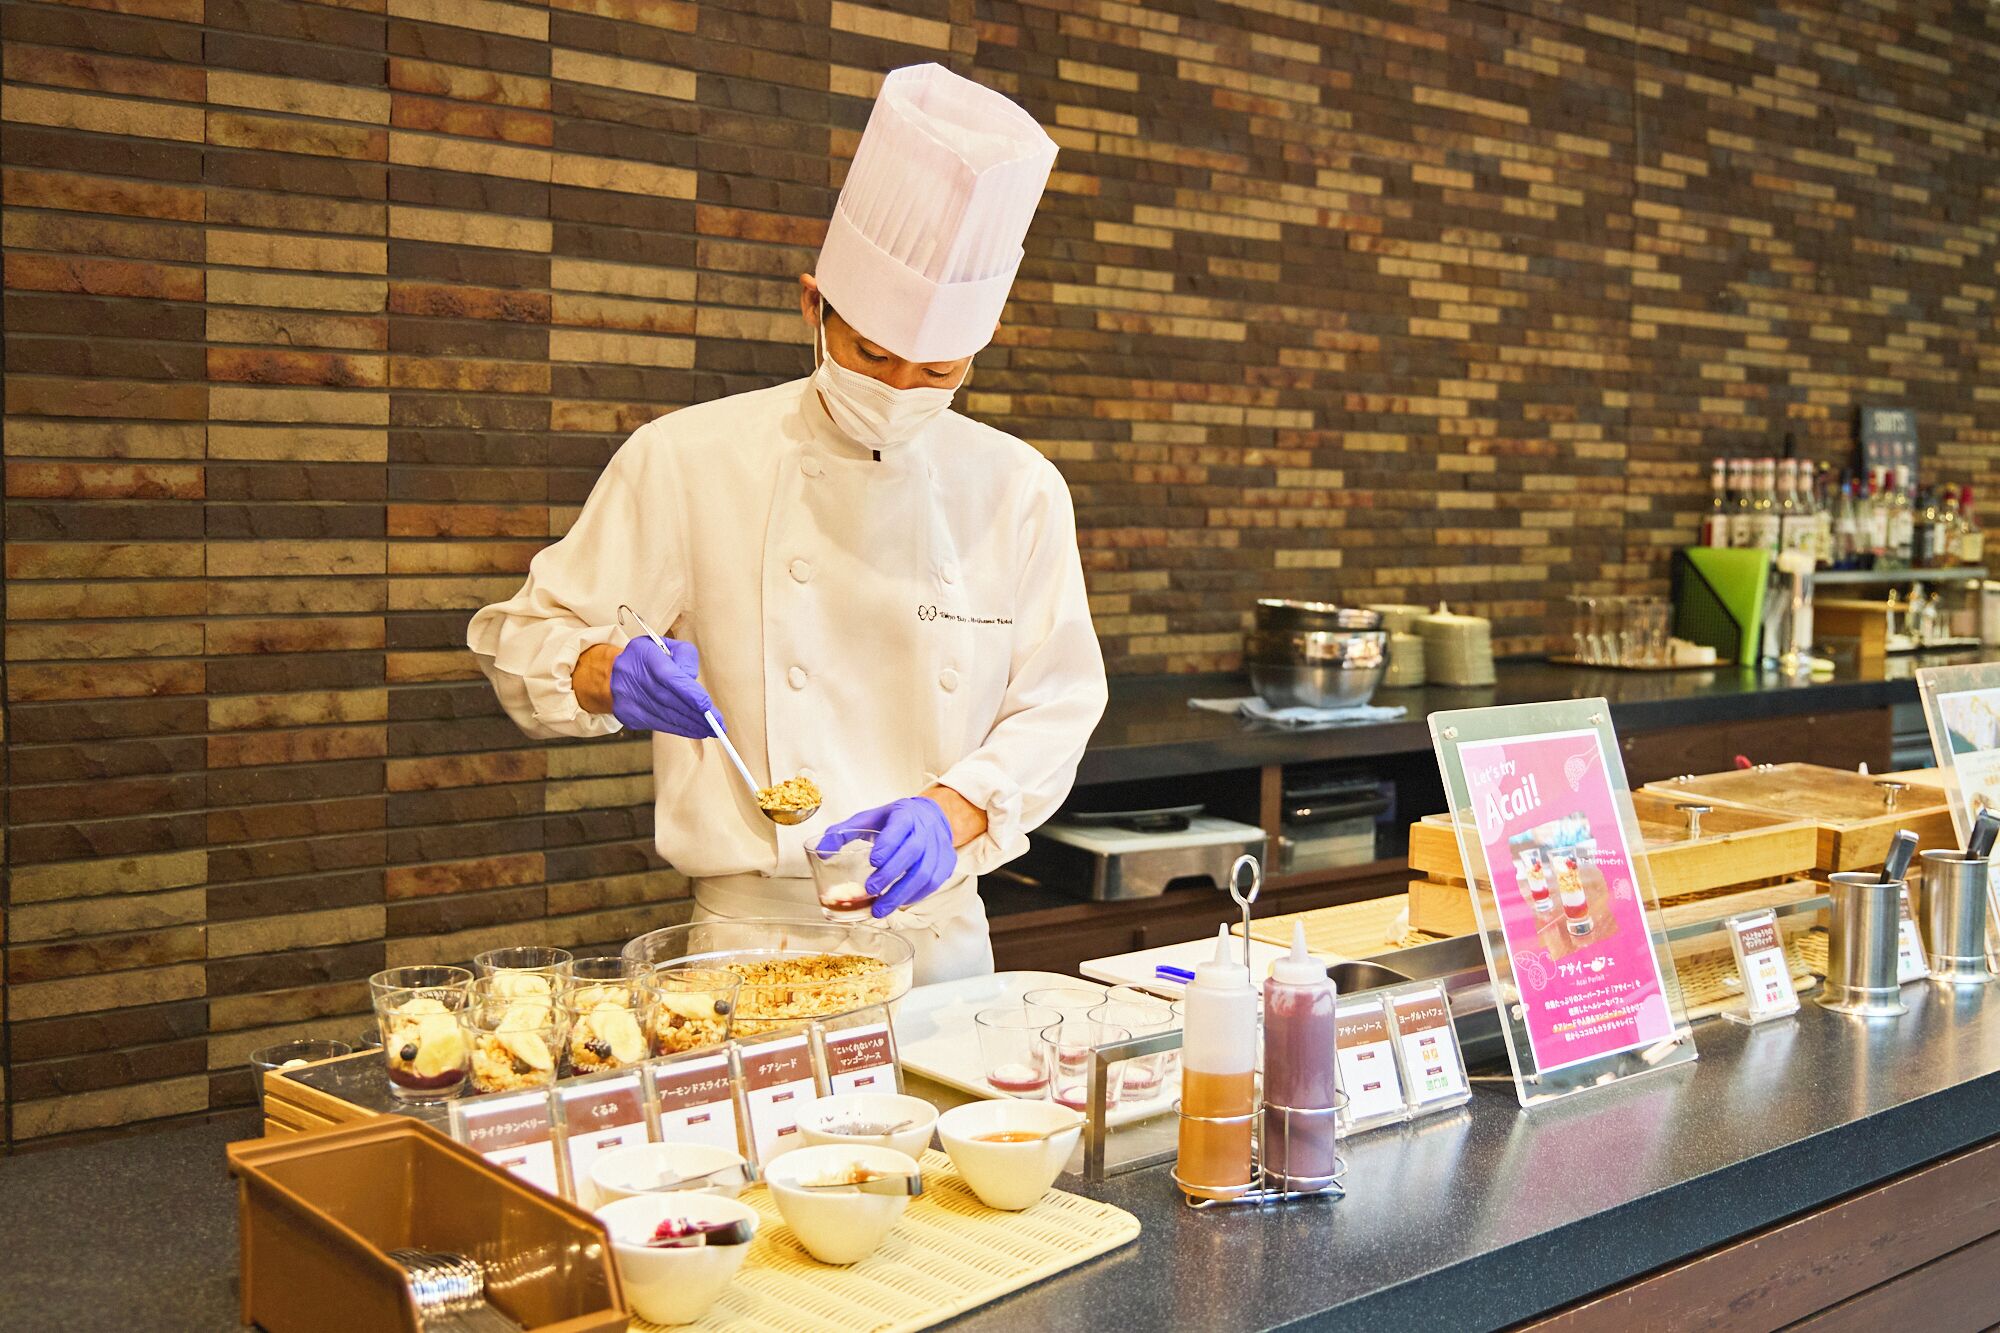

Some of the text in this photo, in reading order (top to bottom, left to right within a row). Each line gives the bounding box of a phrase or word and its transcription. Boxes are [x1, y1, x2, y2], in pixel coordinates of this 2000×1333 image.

[1472, 759, 1516, 786] Let's try
[1485, 772, 1542, 830] Acai!
[1399, 1007, 1443, 1025] ヨーグルトパフェ
[1338, 1020, 1383, 1037] アサイーソース
[758, 1058, 798, 1076] チアシード
[840, 1051, 881, 1066] マンゴーソース
[659, 1076, 730, 1100] アーモンドスライス
[591, 1102, 619, 1118] くるみ
[469, 1118, 547, 1142] ドライクランベリー
